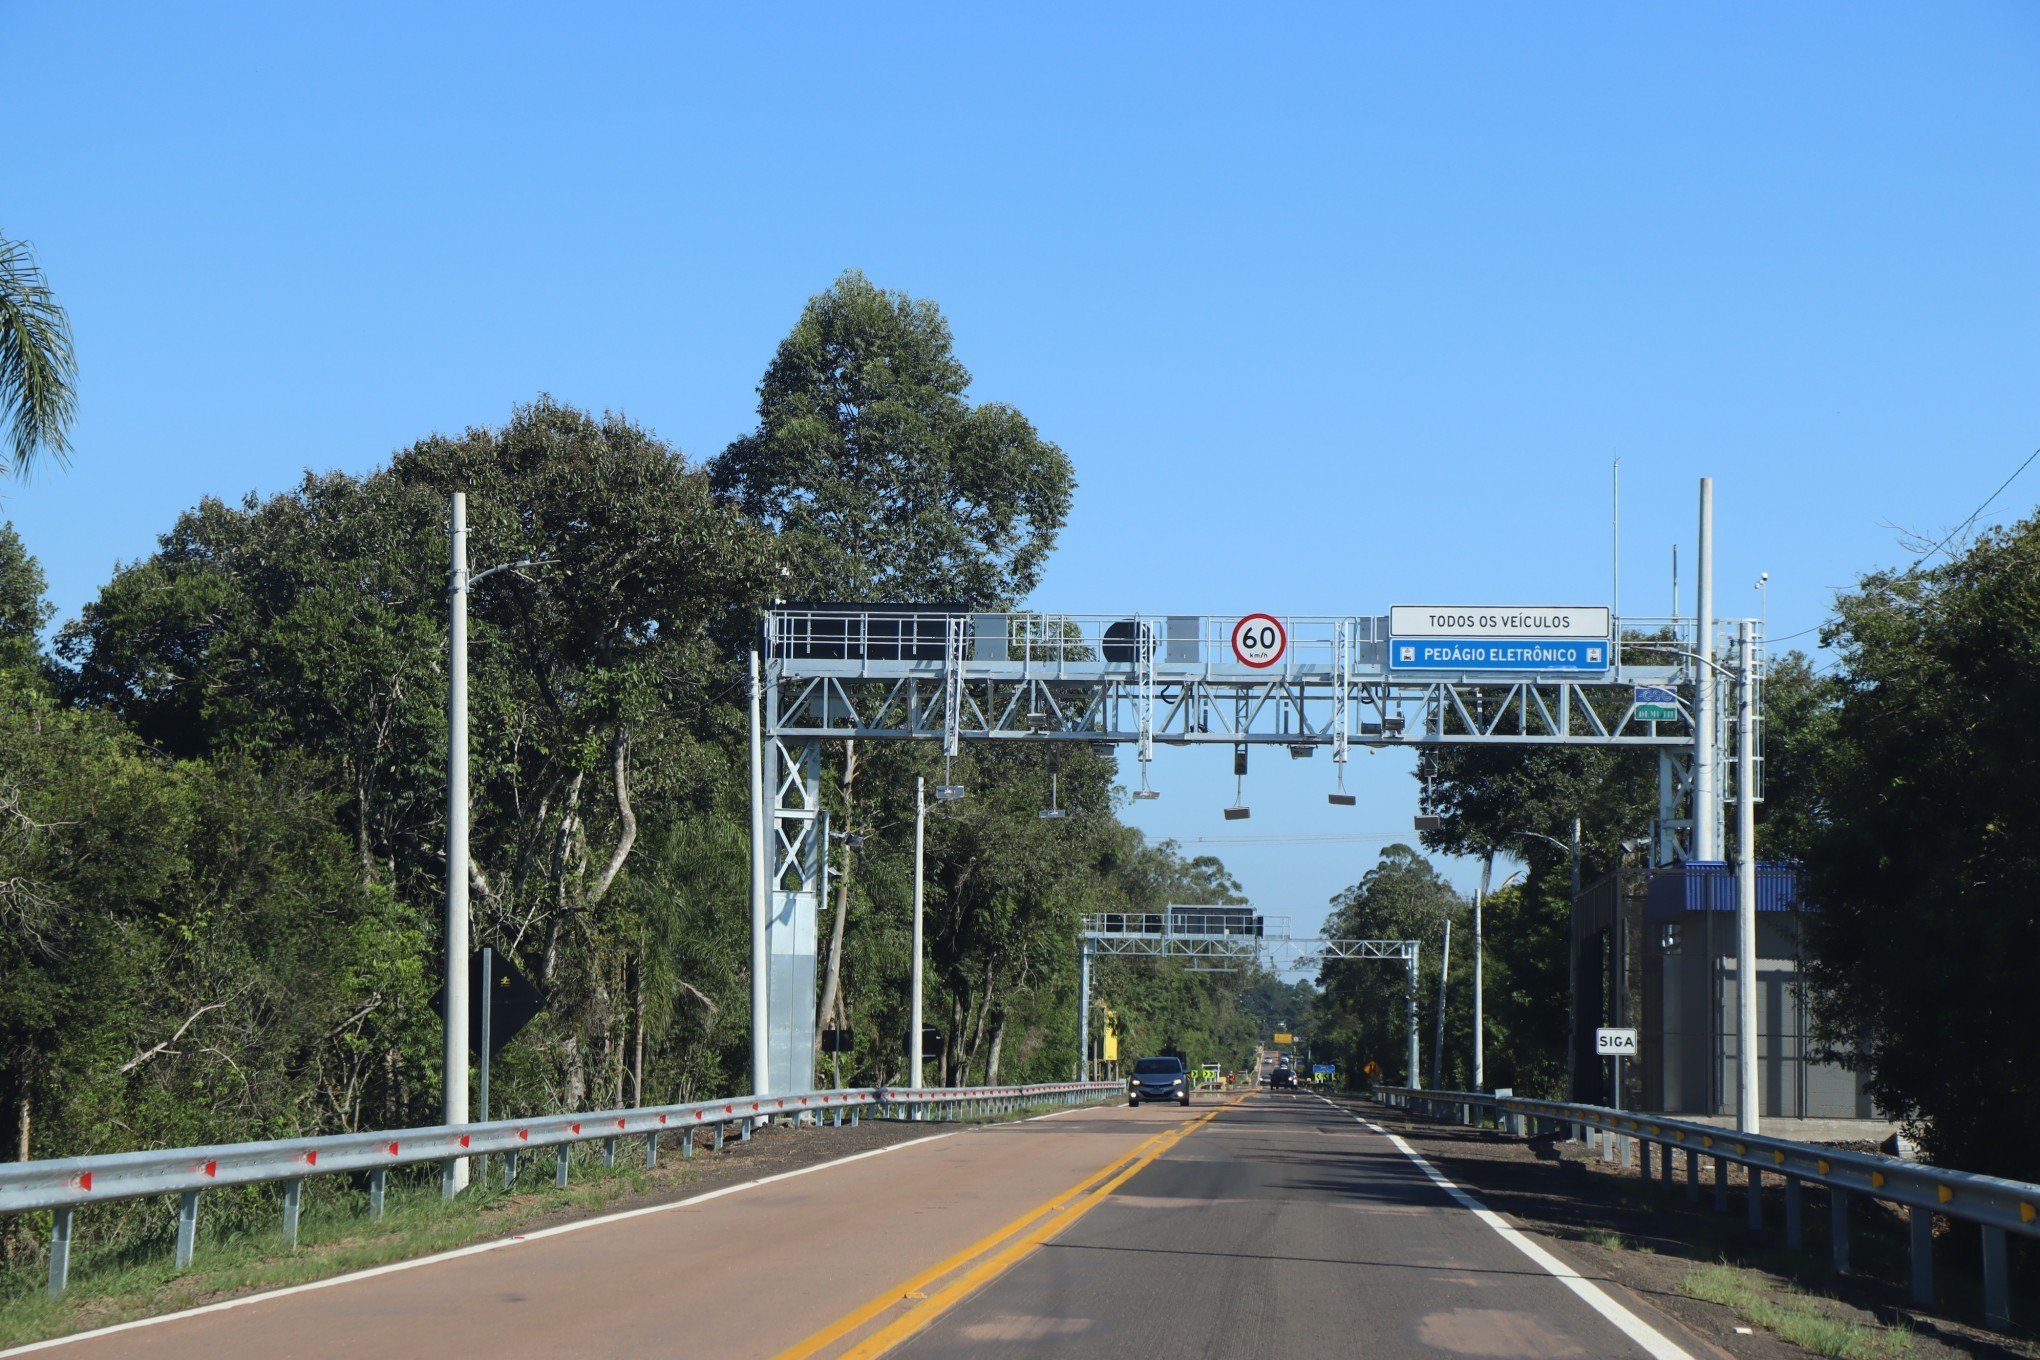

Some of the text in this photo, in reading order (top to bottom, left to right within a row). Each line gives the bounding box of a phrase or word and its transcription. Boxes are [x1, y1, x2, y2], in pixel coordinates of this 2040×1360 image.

[1429, 612, 1570, 628] TODOS OS VEÍCULOS
[1242, 626, 1276, 649] 60
[1424, 644, 1577, 662] PEDÁGIO ELETRÔNICO
[1599, 1035, 1634, 1047] SIGA
